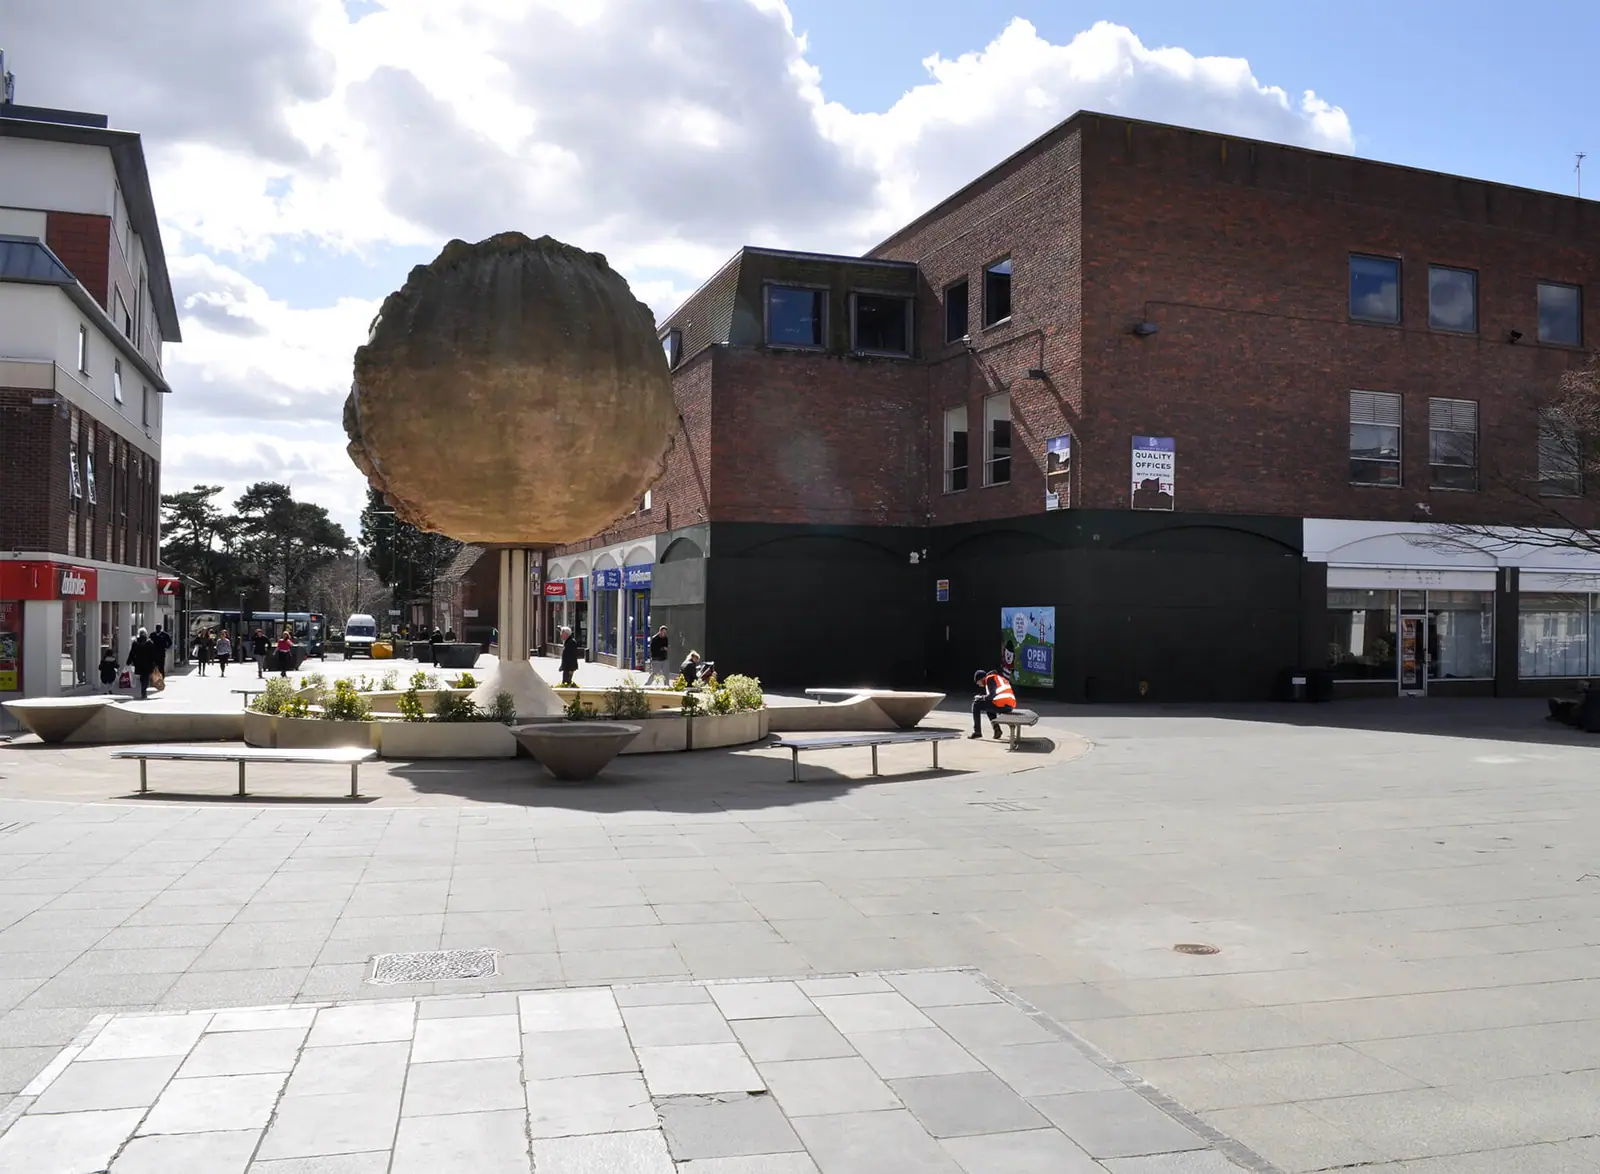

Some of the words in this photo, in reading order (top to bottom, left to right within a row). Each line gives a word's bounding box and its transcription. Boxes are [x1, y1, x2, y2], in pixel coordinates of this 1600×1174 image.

[1135, 452, 1172, 460] QUALITY
[1135, 462, 1172, 470] OFFICES
[1027, 648, 1047, 662] OPEN
